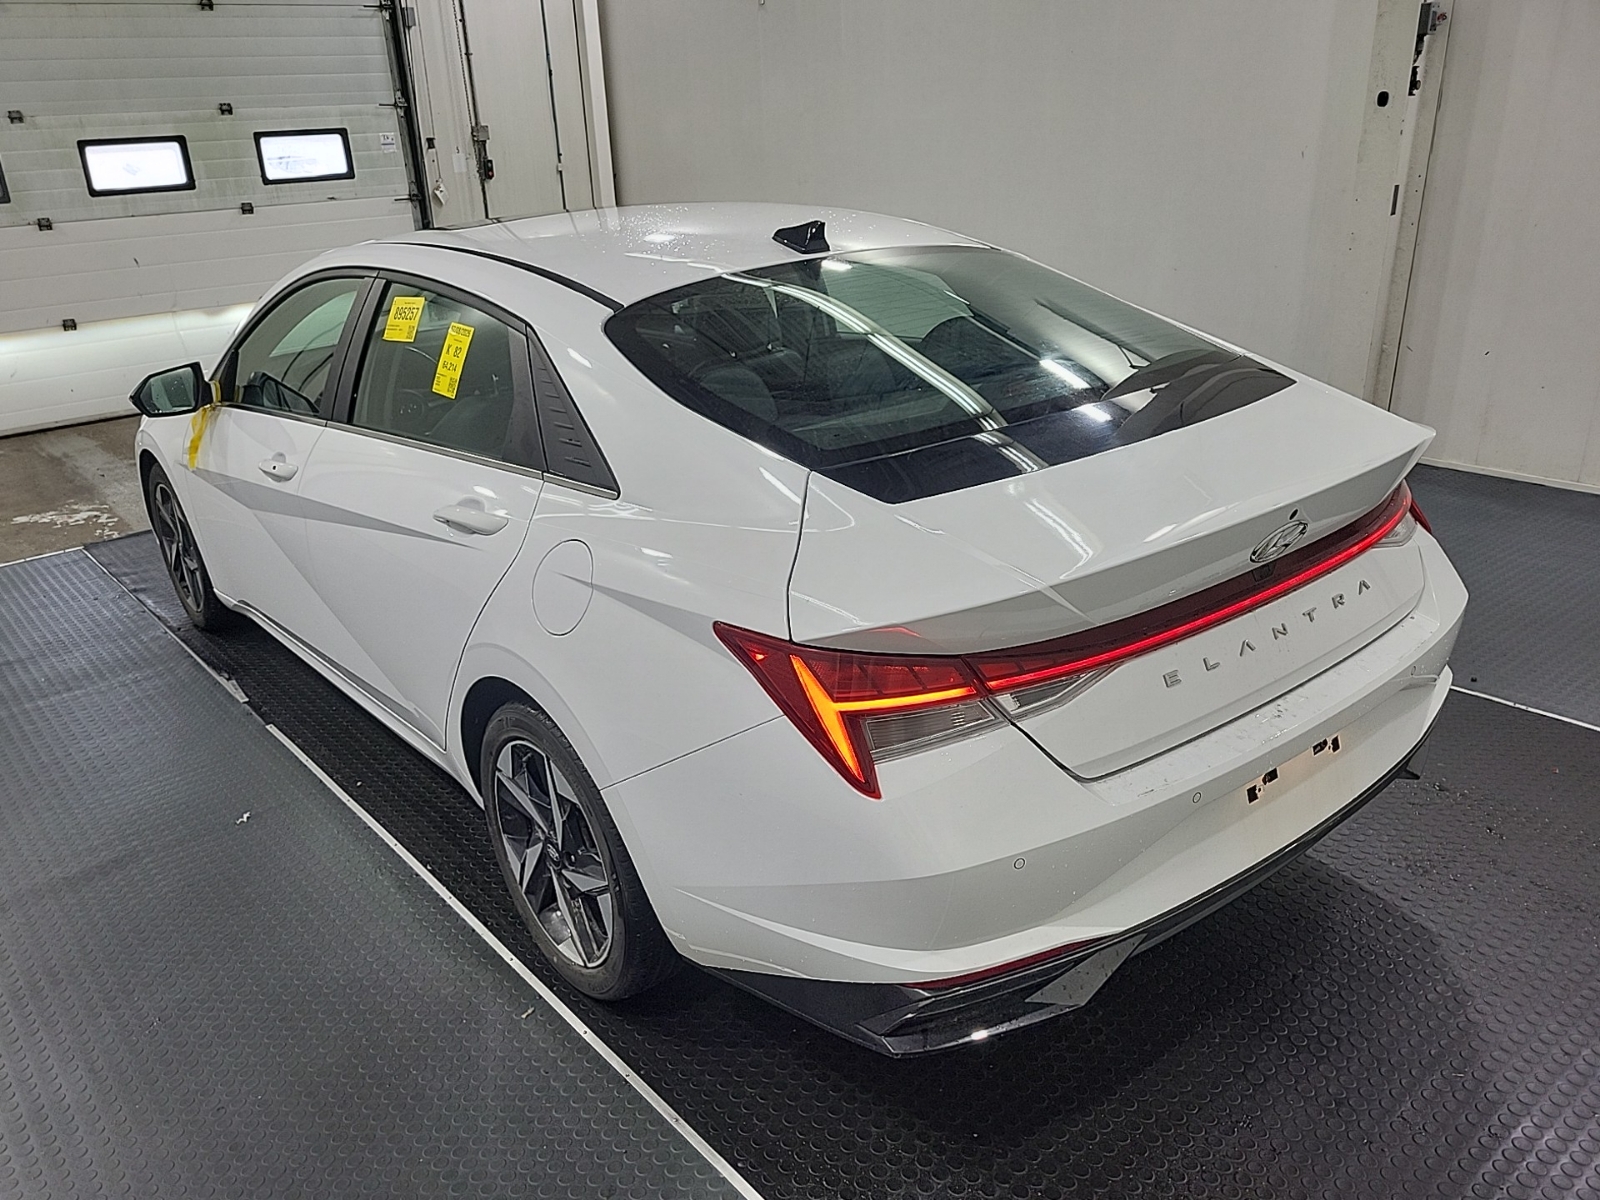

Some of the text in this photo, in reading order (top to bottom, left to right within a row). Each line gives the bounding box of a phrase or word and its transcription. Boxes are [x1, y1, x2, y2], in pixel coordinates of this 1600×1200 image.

[394, 307, 420, 321] 895257
[453, 346, 462, 358] 82
[1162, 579, 1372, 689] ELANTRA
